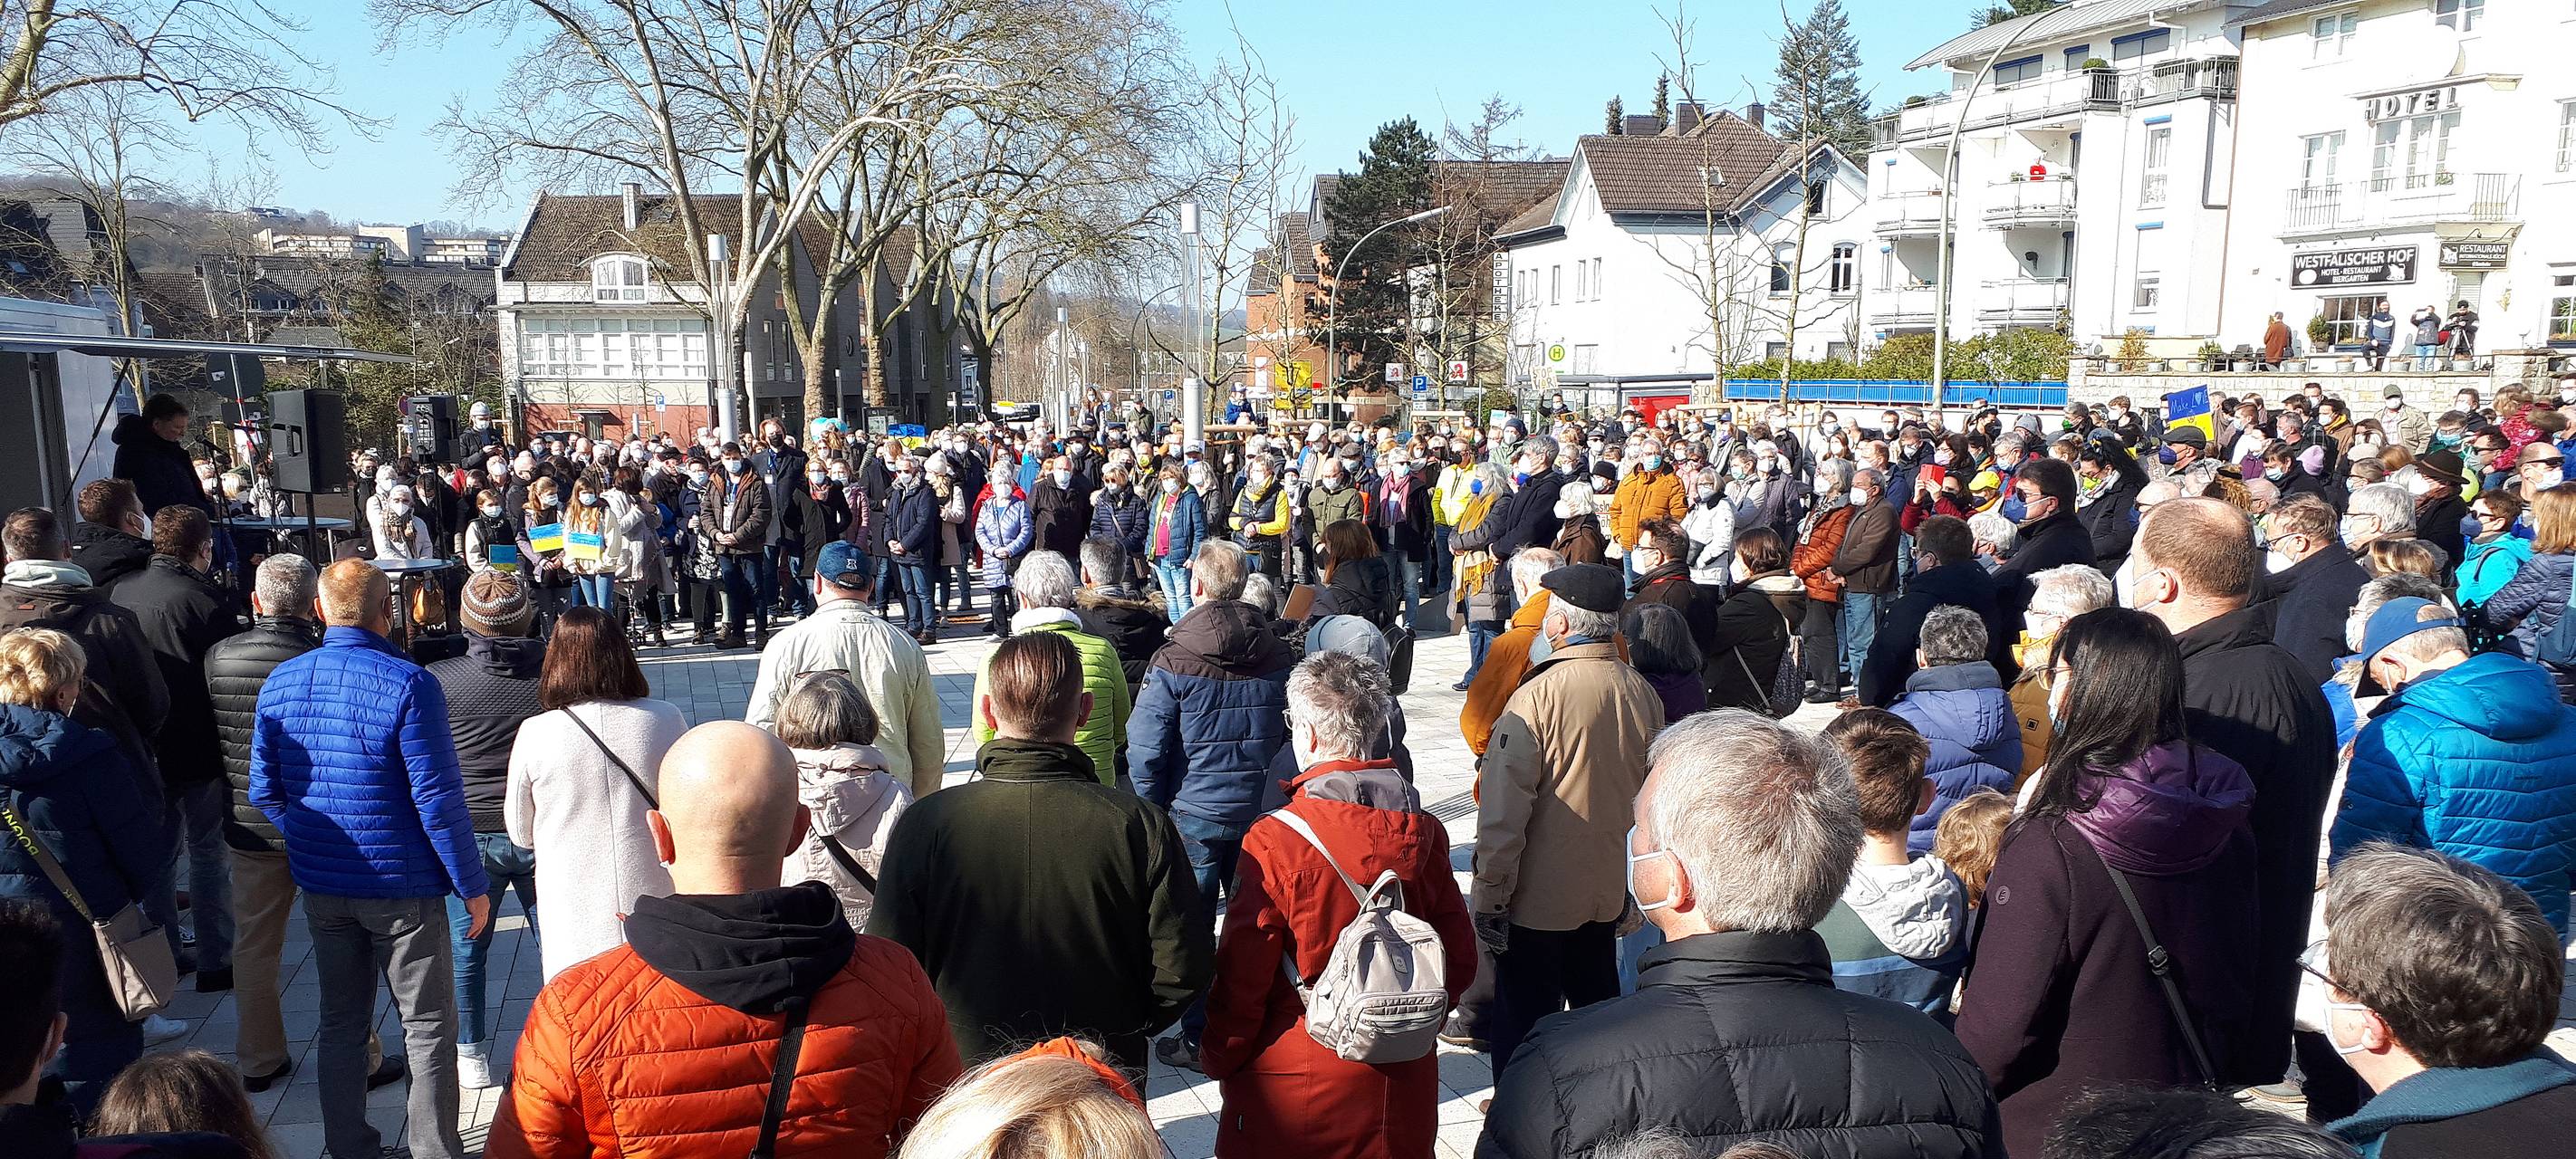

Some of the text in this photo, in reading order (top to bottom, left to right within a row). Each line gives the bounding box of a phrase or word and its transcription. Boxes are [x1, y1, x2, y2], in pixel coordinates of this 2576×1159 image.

[2364, 87, 2458, 120] HOTEL
[2459, 244, 2507, 254] RESTAURANT
[2294, 248, 2416, 269] WESTFÄLISCHER HOF
[2332, 274, 2369, 283] BIERGARTEN
[1494, 253, 1503, 321] APOTHEKE
[1552, 348, 1561, 359] H
[1415, 378, 1424, 389] P
[2170, 398, 2189, 415] Make
